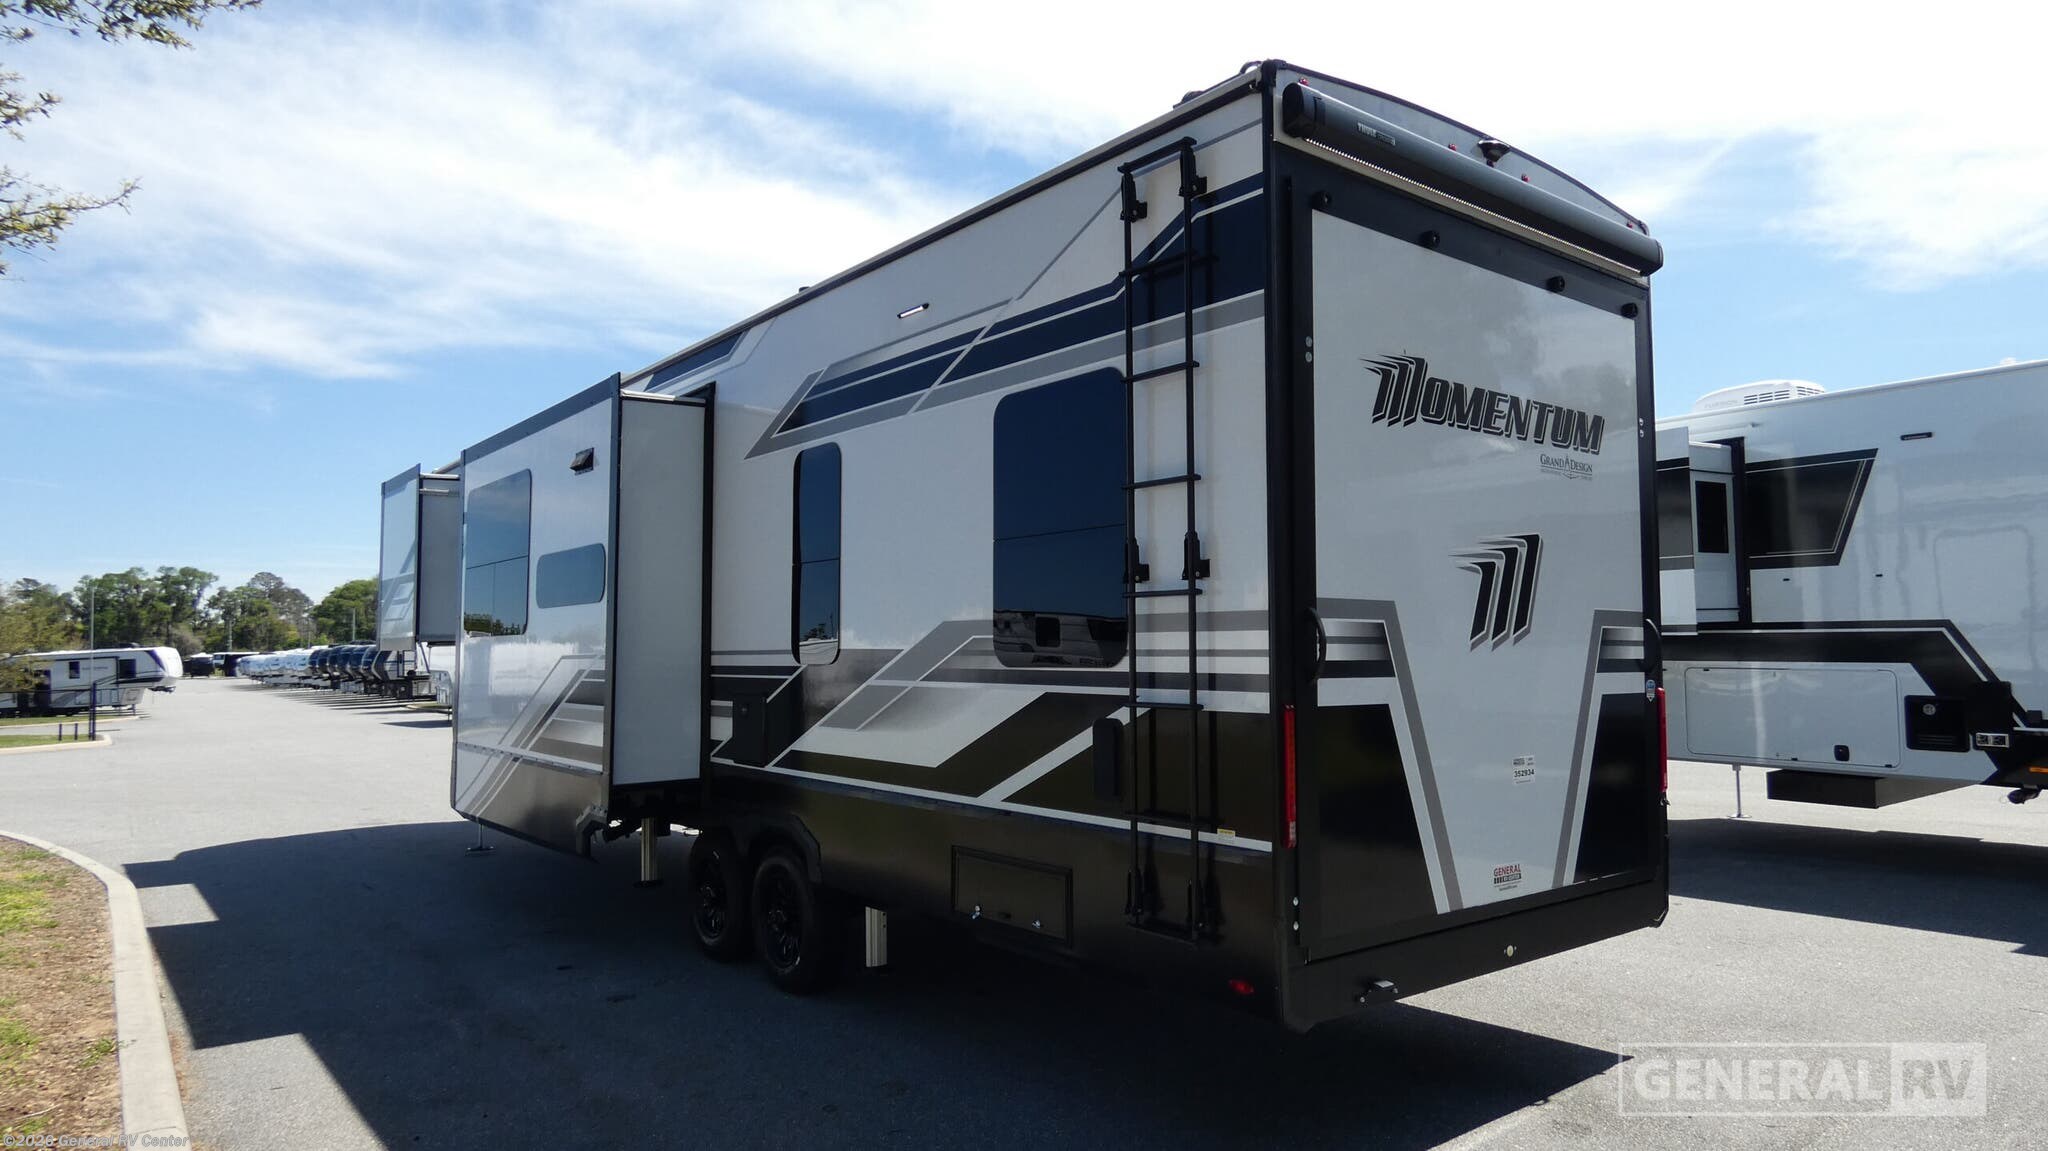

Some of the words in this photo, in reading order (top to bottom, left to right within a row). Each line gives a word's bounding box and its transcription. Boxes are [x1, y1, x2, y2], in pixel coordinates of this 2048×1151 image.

[1359, 353, 1605, 455] MOMENTUM
[1540, 453, 1565, 468] GRAND
[1570, 459, 1593, 473] DESIGN
[1493, 863, 1521, 877] GENERAL
